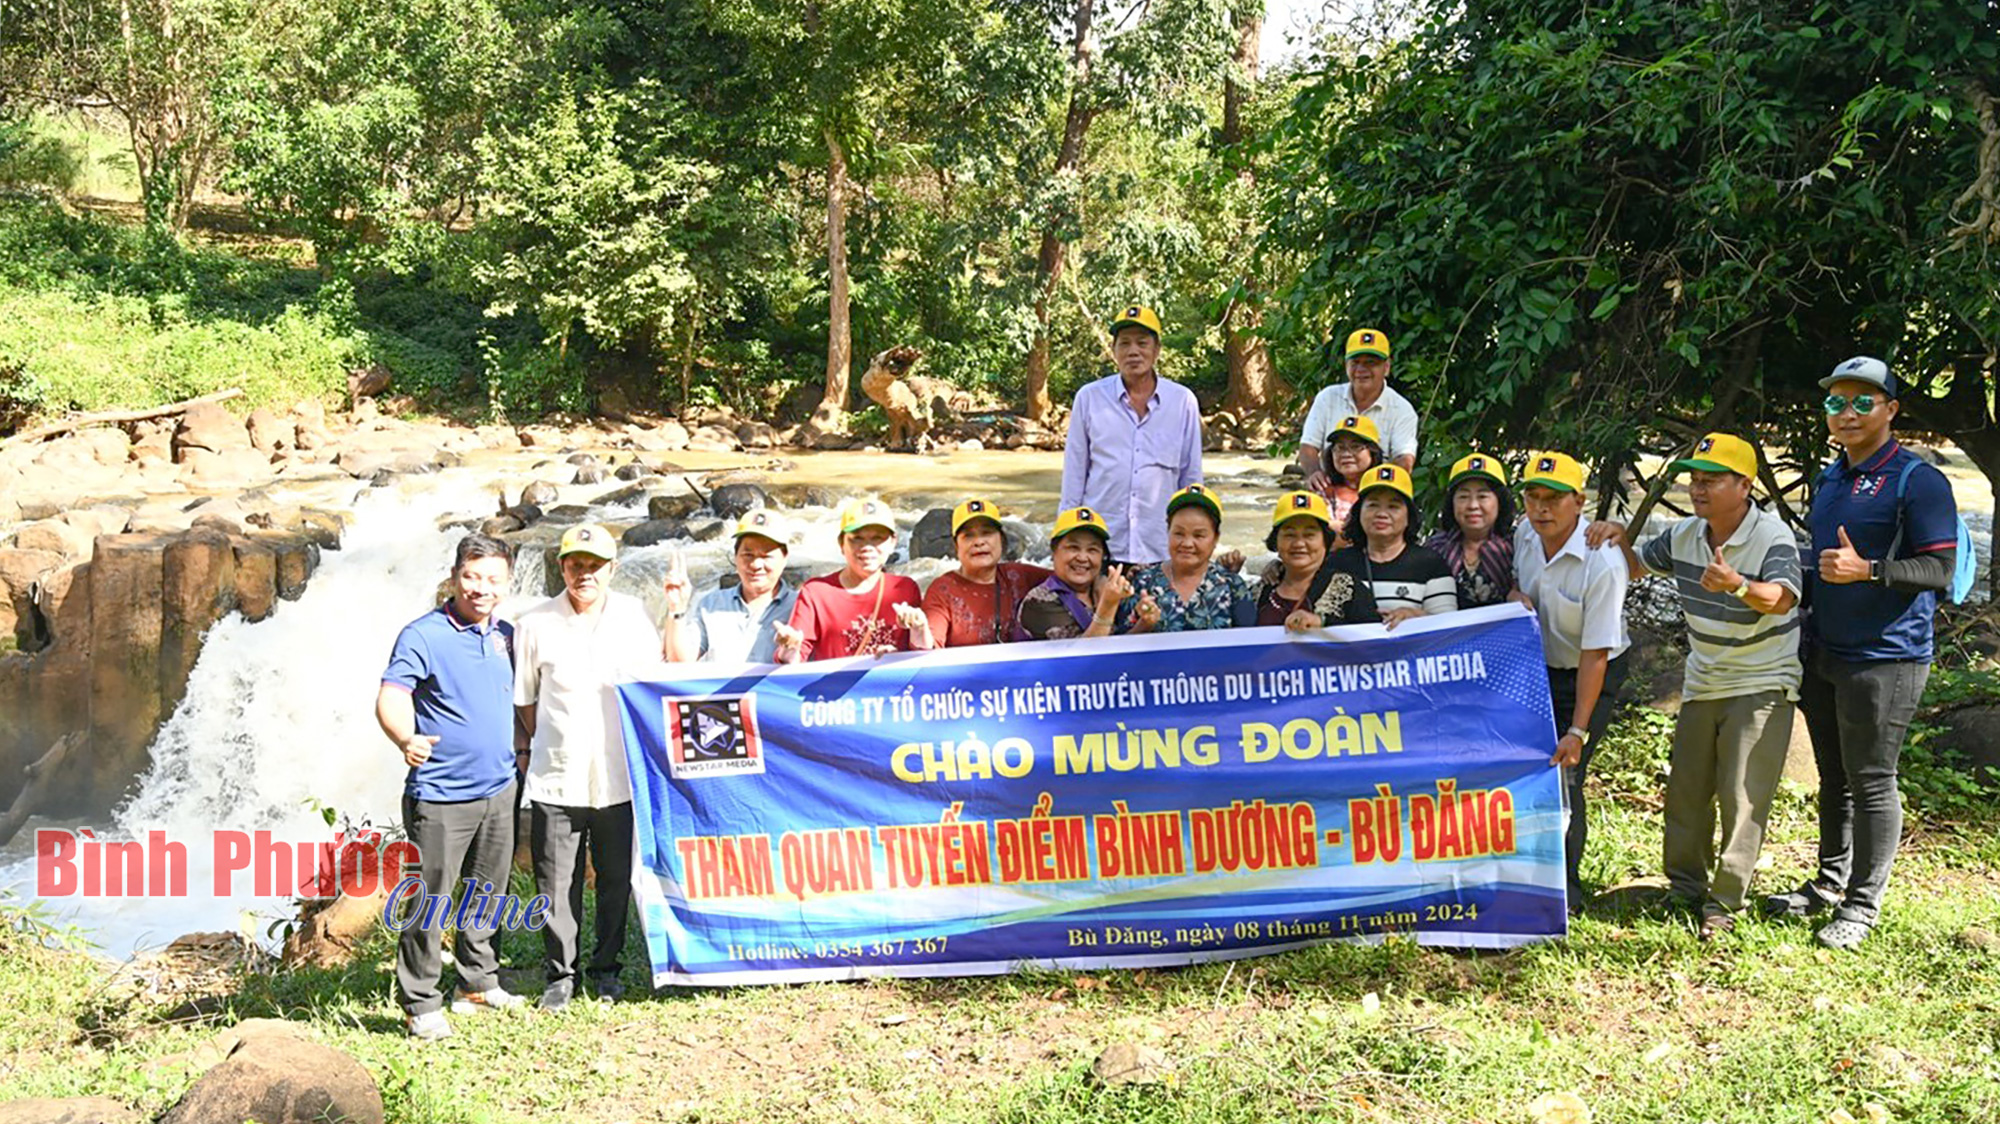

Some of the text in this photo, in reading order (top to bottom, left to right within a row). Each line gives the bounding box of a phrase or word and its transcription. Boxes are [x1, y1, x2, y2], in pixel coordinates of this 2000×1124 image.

[801, 651, 1487, 727] CÔNG TY TỔ CHỨC SỰ KIỆN TRUYỀN THÔNG DU LỊCH NEWSTAR MEDIA
[675, 759, 758, 773] NEWSTAR MEDIA
[890, 706, 1403, 783] CHÀO MỪNG ĐOÀN
[675, 834, 776, 899] THAM
[779, 828, 874, 901] QUAN
[876, 801, 994, 888] TUYẾN
[994, 792, 1091, 883] ĐIỂM
[1093, 800, 1187, 879] BÌNH
[1189, 799, 1319, 874] DƯƠNG
[1348, 783, 1403, 865] BÙ
[1408, 778, 1516, 862] ĐĂNG
[728, 936, 948, 962] Hotline: 0354 367 367
[1067, 903, 1478, 948] Bù Đăng, ngày 08 tháng 11 năm 2024
